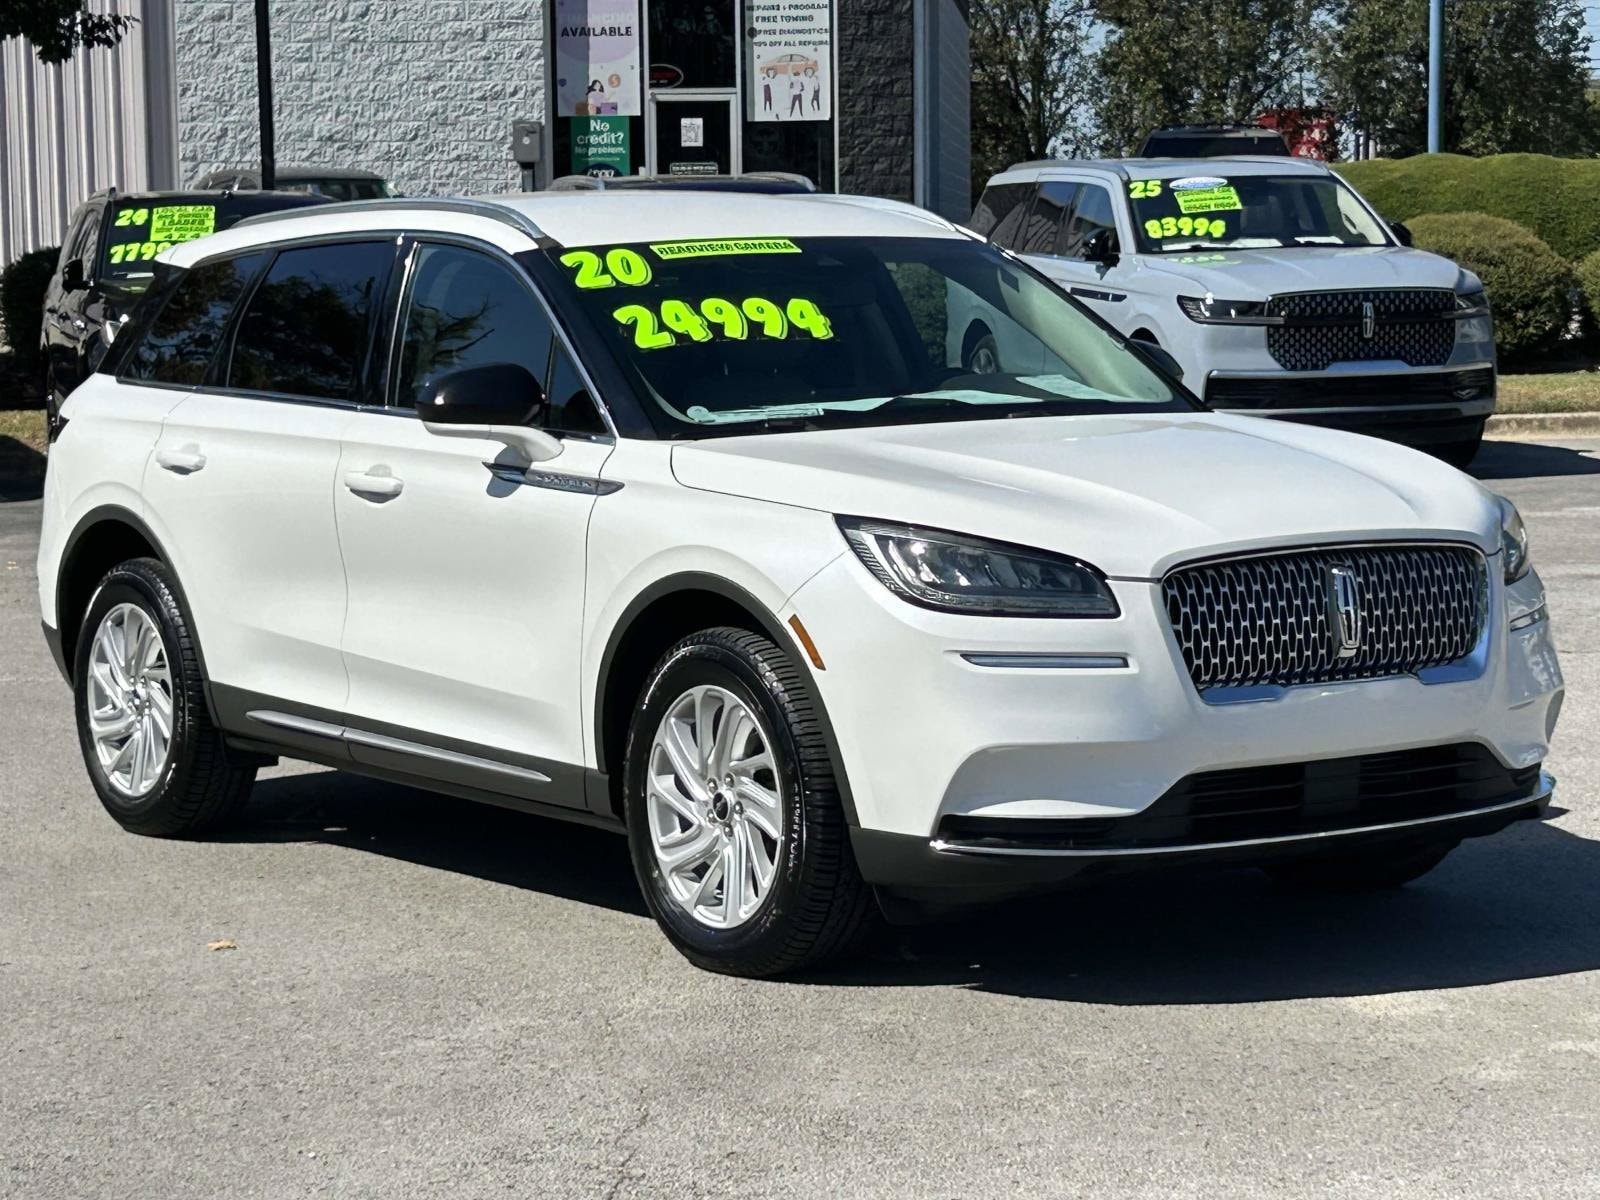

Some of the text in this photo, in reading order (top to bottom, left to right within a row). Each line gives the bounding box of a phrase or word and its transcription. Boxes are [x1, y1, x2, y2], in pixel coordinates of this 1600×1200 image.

[561, 26, 632, 37] AVAILABLE
[590, 120, 610, 131] No
[576, 132, 624, 144] credit?
[1129, 180, 1162, 198] 25
[115, 209, 148, 226] 24
[1144, 217, 1226, 238] 83994
[559, 248, 652, 289] 20
[612, 297, 833, 349] 24994
